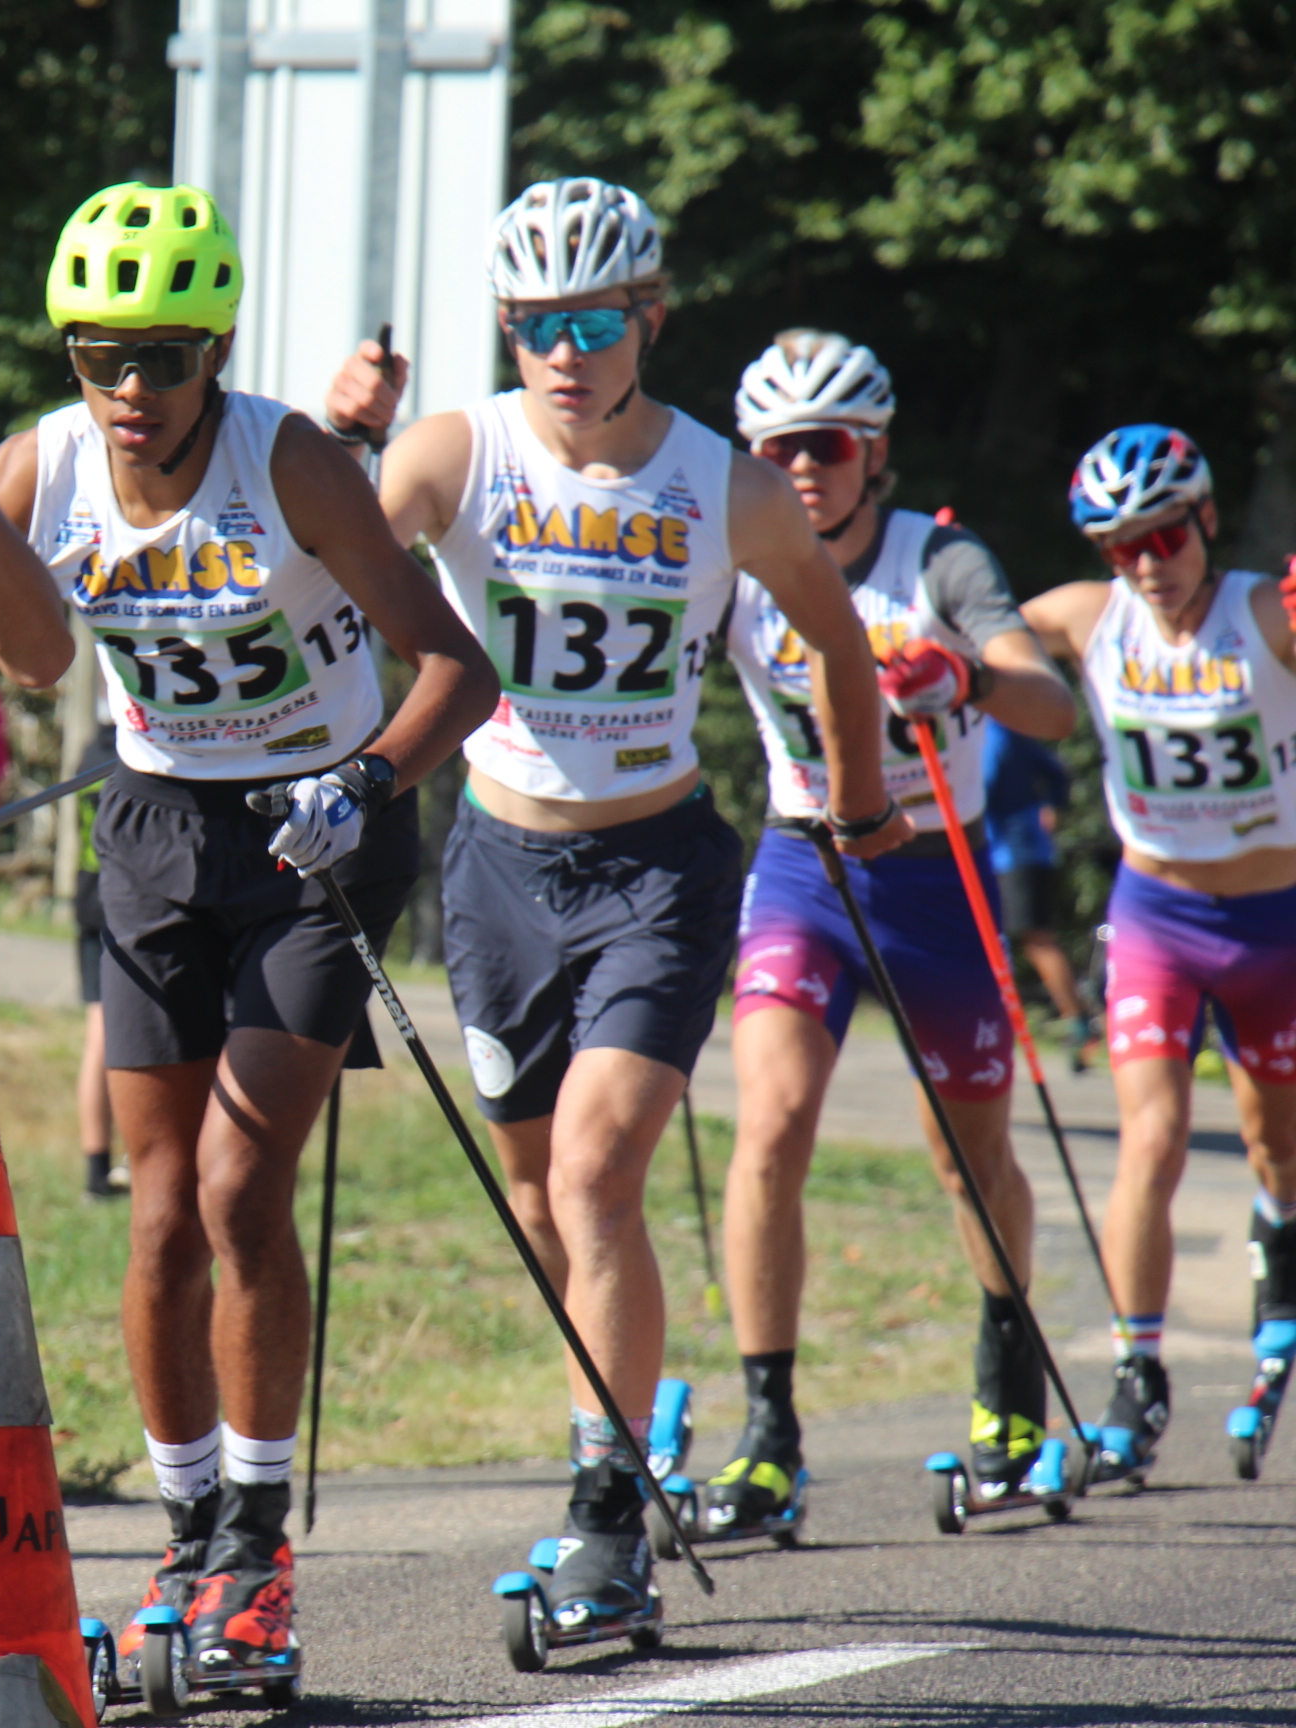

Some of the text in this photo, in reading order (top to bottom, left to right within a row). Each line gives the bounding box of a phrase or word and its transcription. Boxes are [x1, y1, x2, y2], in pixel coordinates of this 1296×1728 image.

[497, 500, 690, 569] SAMSE
[74, 541, 263, 602] SAMSE
[124, 604, 143, 617] LES
[209, 605, 225, 618] EN
[304, 604, 373, 667] 13
[103, 623, 288, 706] 135
[497, 596, 673, 694] 132
[215, 690, 319, 728] D'EPARGNE
[517, 706, 674, 727] CAISSE D'EPARGNE
[1123, 727, 1260, 790] 133
[351, 930, 417, 1042] barnett
